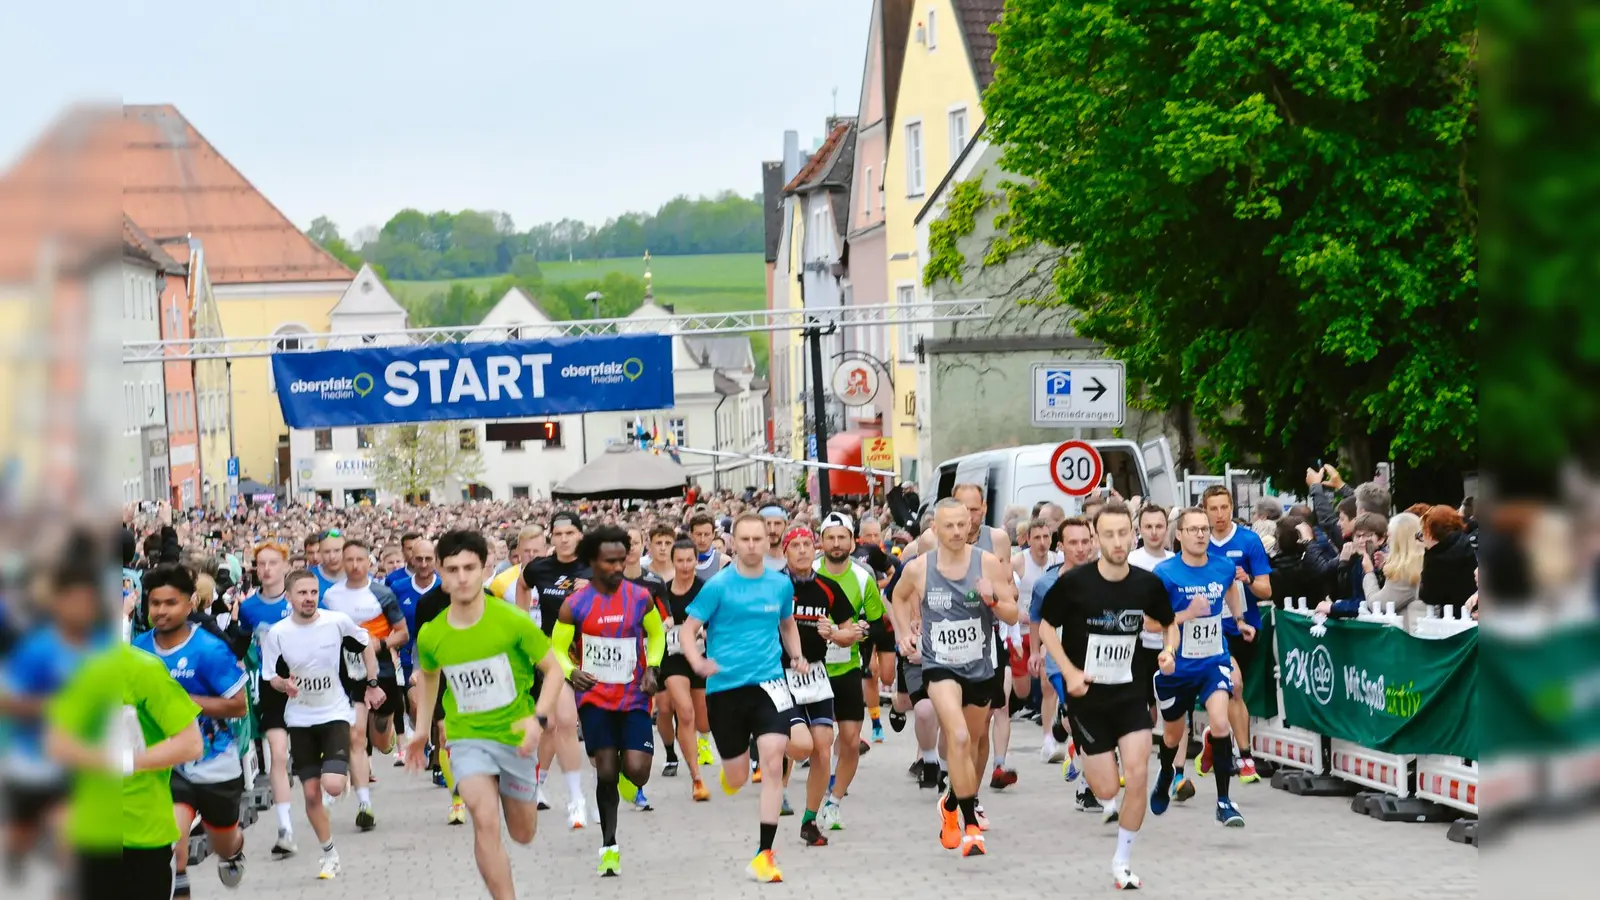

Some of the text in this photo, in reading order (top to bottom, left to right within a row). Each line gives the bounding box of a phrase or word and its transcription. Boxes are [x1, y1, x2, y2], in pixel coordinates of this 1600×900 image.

[560, 361, 623, 378] oberpfalz
[290, 377, 353, 394] oberpfalz
[383, 353, 553, 408] START
[591, 375, 624, 385] medien
[321, 390, 354, 401] medien
[1039, 409, 1115, 420] Schmiedrangen
[867, 453, 891, 461] LOTTO
[1061, 456, 1090, 481] 30
[1185, 585, 1207, 593] BAYERN
[938, 626, 977, 645] 4893
[1193, 623, 1218, 640] 814
[586, 643, 622, 662] 2535
[1094, 644, 1132, 660] 1906
[295, 676, 331, 692] 2808
[451, 667, 495, 691] 1968
